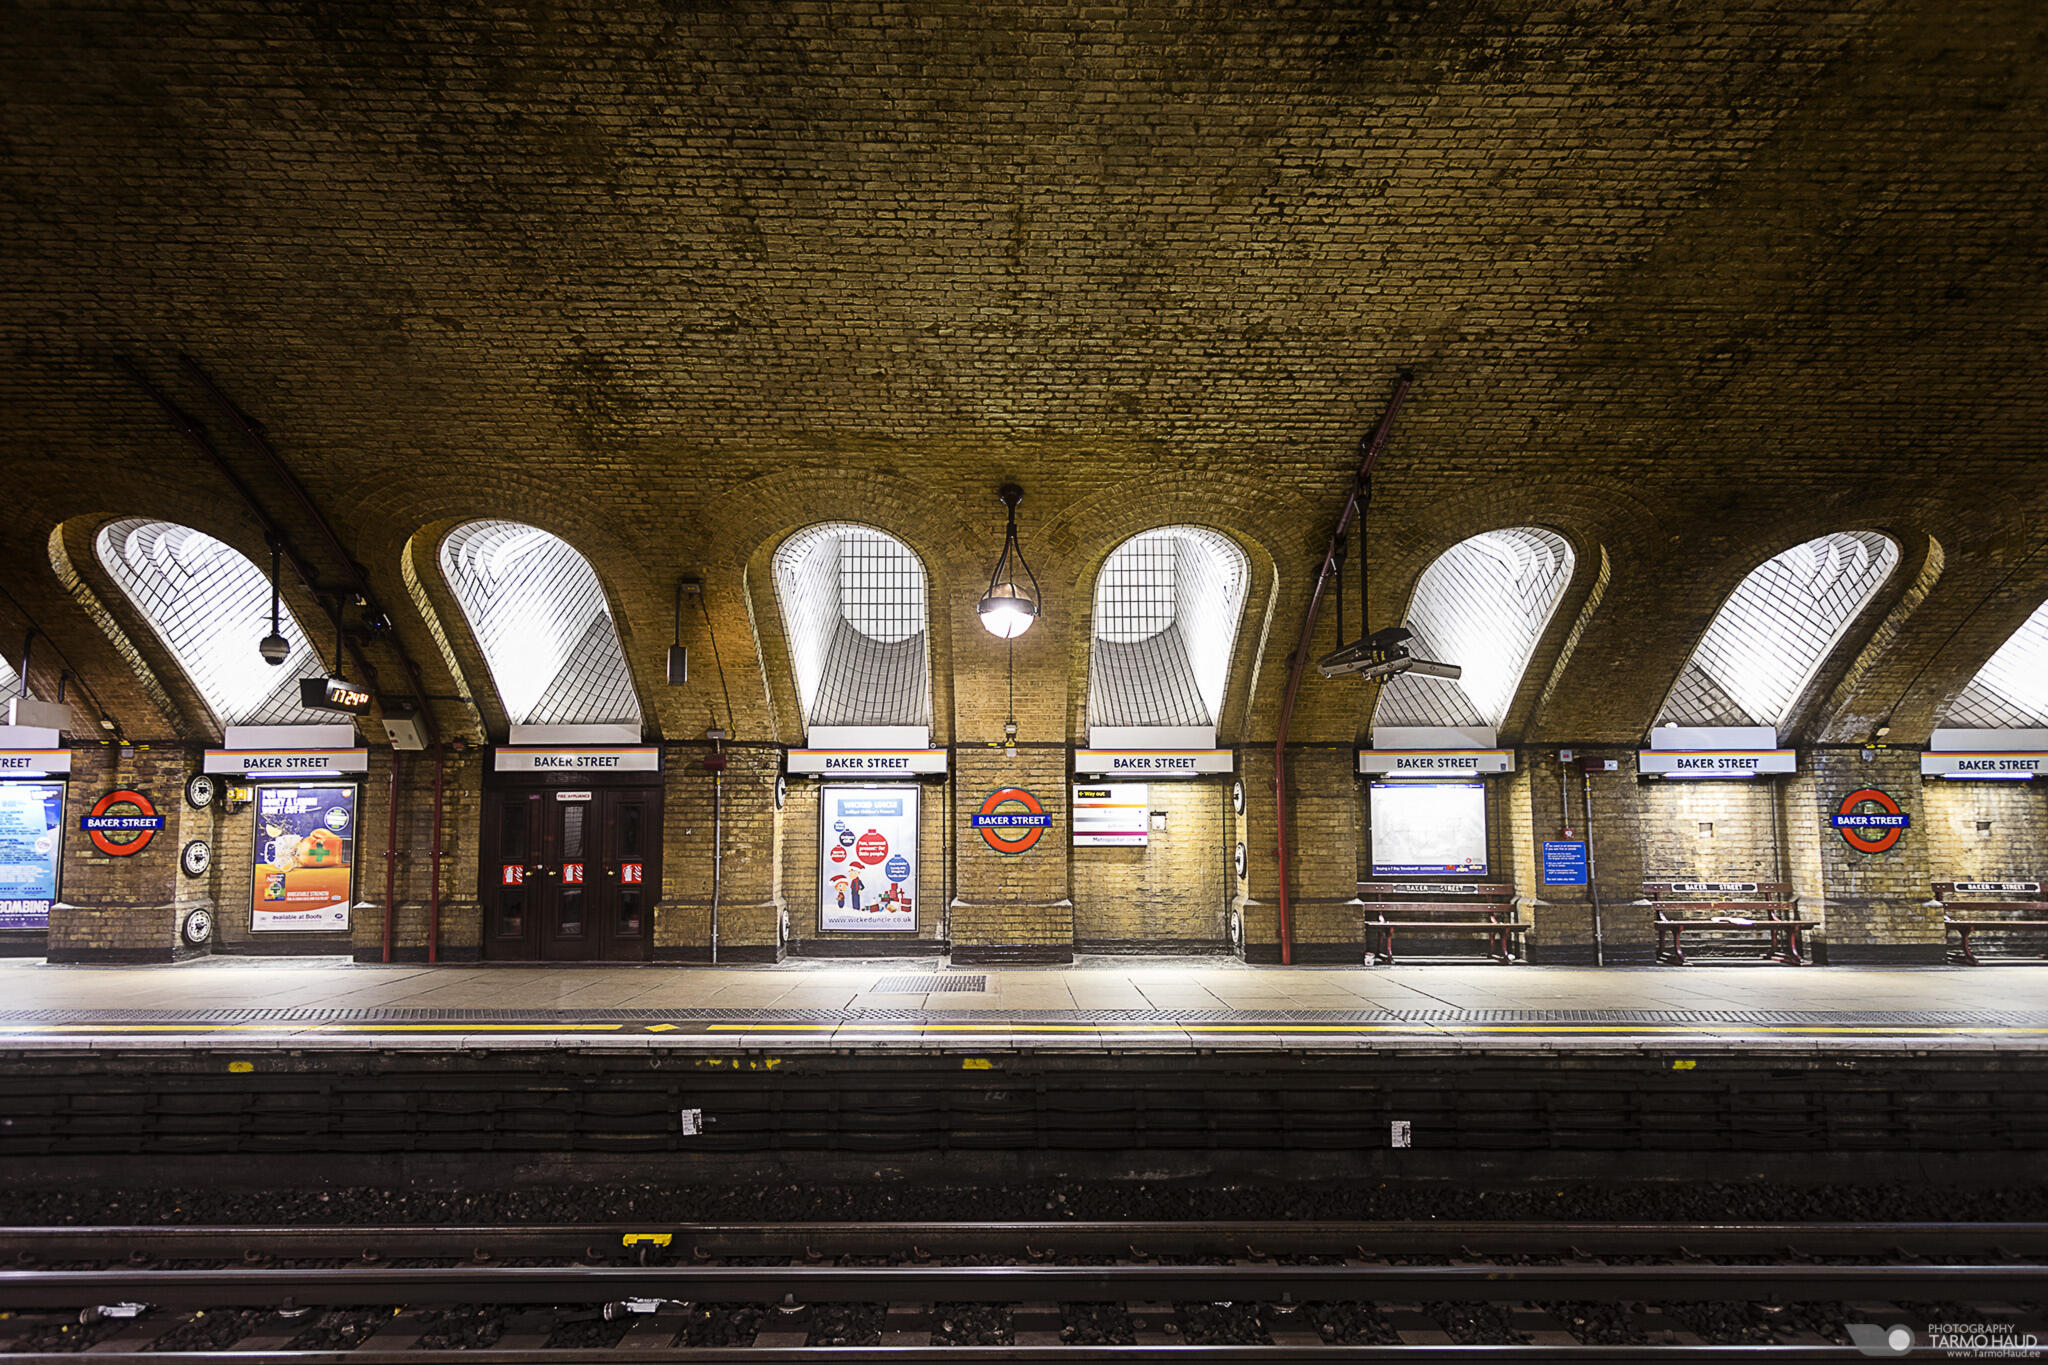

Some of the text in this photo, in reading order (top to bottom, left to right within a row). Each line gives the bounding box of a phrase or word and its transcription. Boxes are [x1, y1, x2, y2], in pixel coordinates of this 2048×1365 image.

[0, 758, 32, 768] REET
[244, 758, 329, 768] BAKER STREET
[535, 757, 620, 767] BAKER STREET
[826, 758, 910, 769] BAKER STREET
[1113, 758, 1197, 769] BAKER STREET
[1396, 758, 1479, 768] BAKER STREET
[1677, 758, 1759, 769] BAKER STREET
[1958, 760, 2040, 770] BAKER STREET
[87, 818, 158, 828] BAKER STREET
[978, 816, 1047, 826] BAKER STREET
[1837, 816, 1904, 825] BAKER STREET
[1406, 884, 1464, 892] BAKER STREET
[1685, 883, 1743, 891] BAKER STREET
